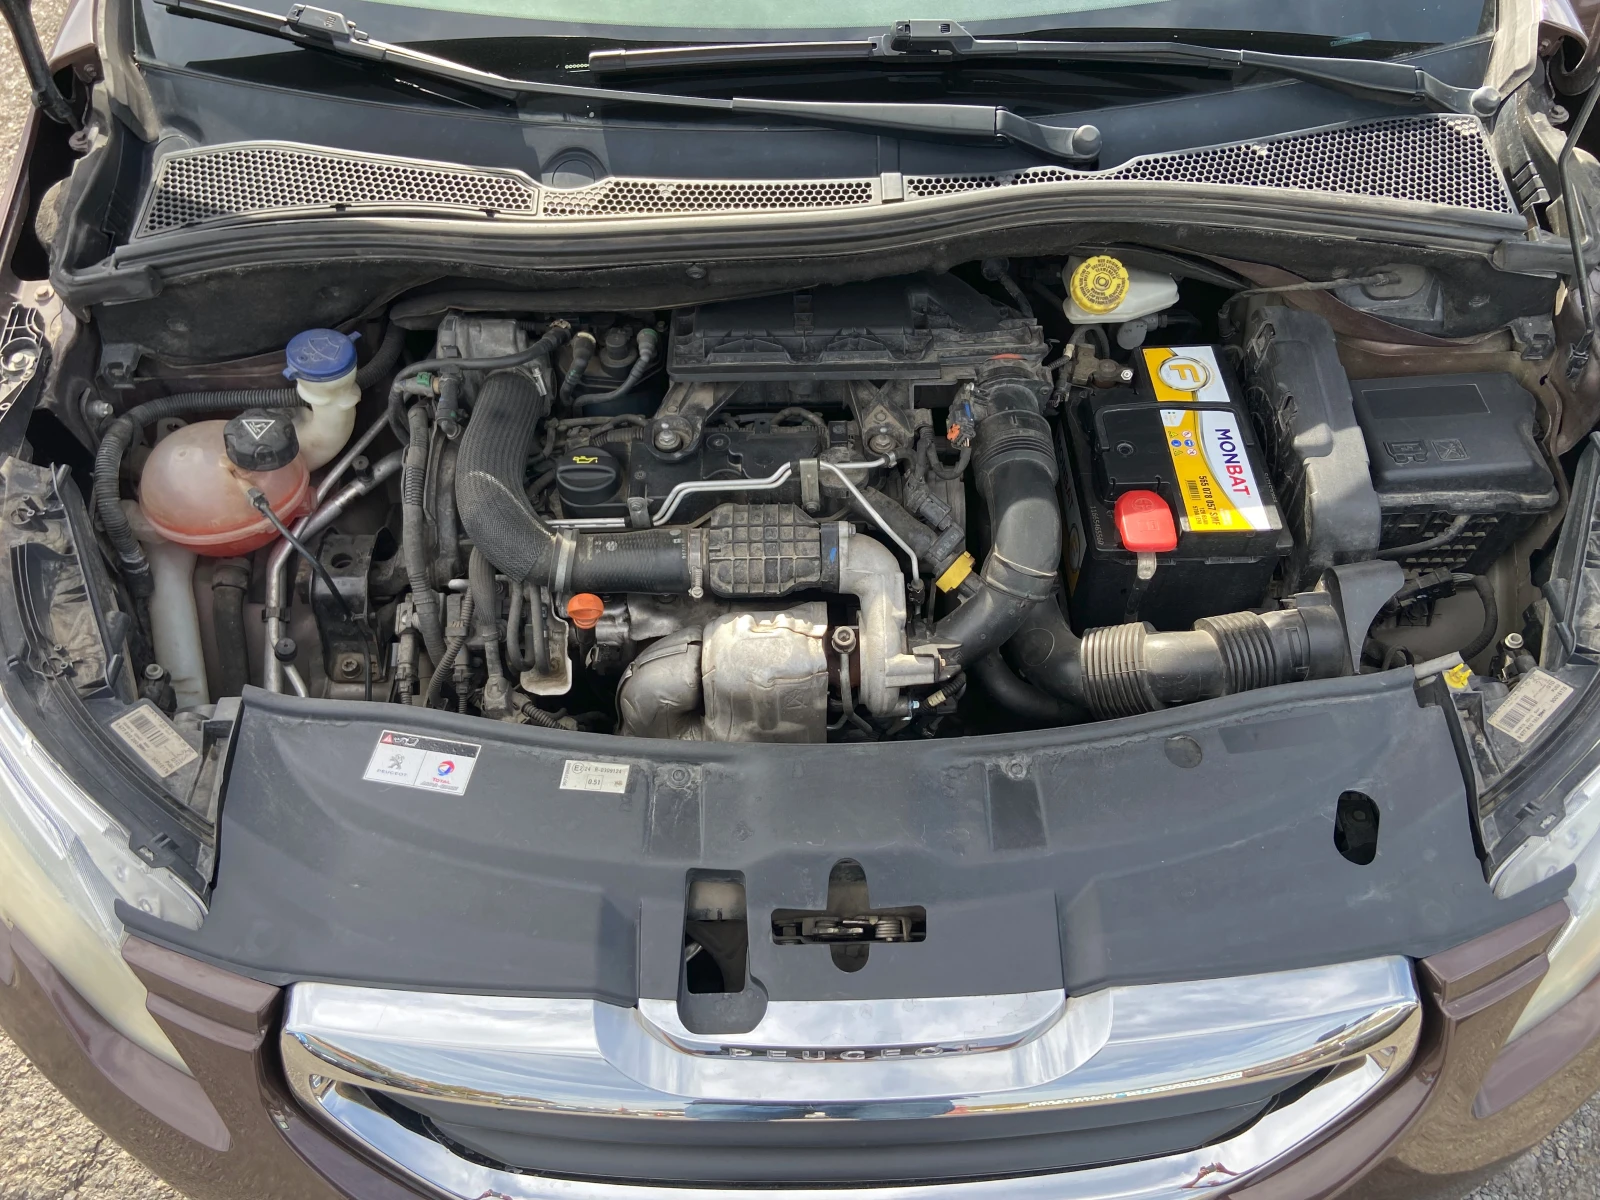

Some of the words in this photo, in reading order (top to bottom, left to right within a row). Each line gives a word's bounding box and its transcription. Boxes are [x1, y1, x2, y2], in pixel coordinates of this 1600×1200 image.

[1214, 428, 1250, 496] MONBAT
[1198, 475, 1208, 486] 565
[1202, 486, 1212, 499] 078
[1205, 499, 1216, 510] 057
[376, 768, 408, 777] PEUGEOT
[431, 776, 451, 785] TOTAL
